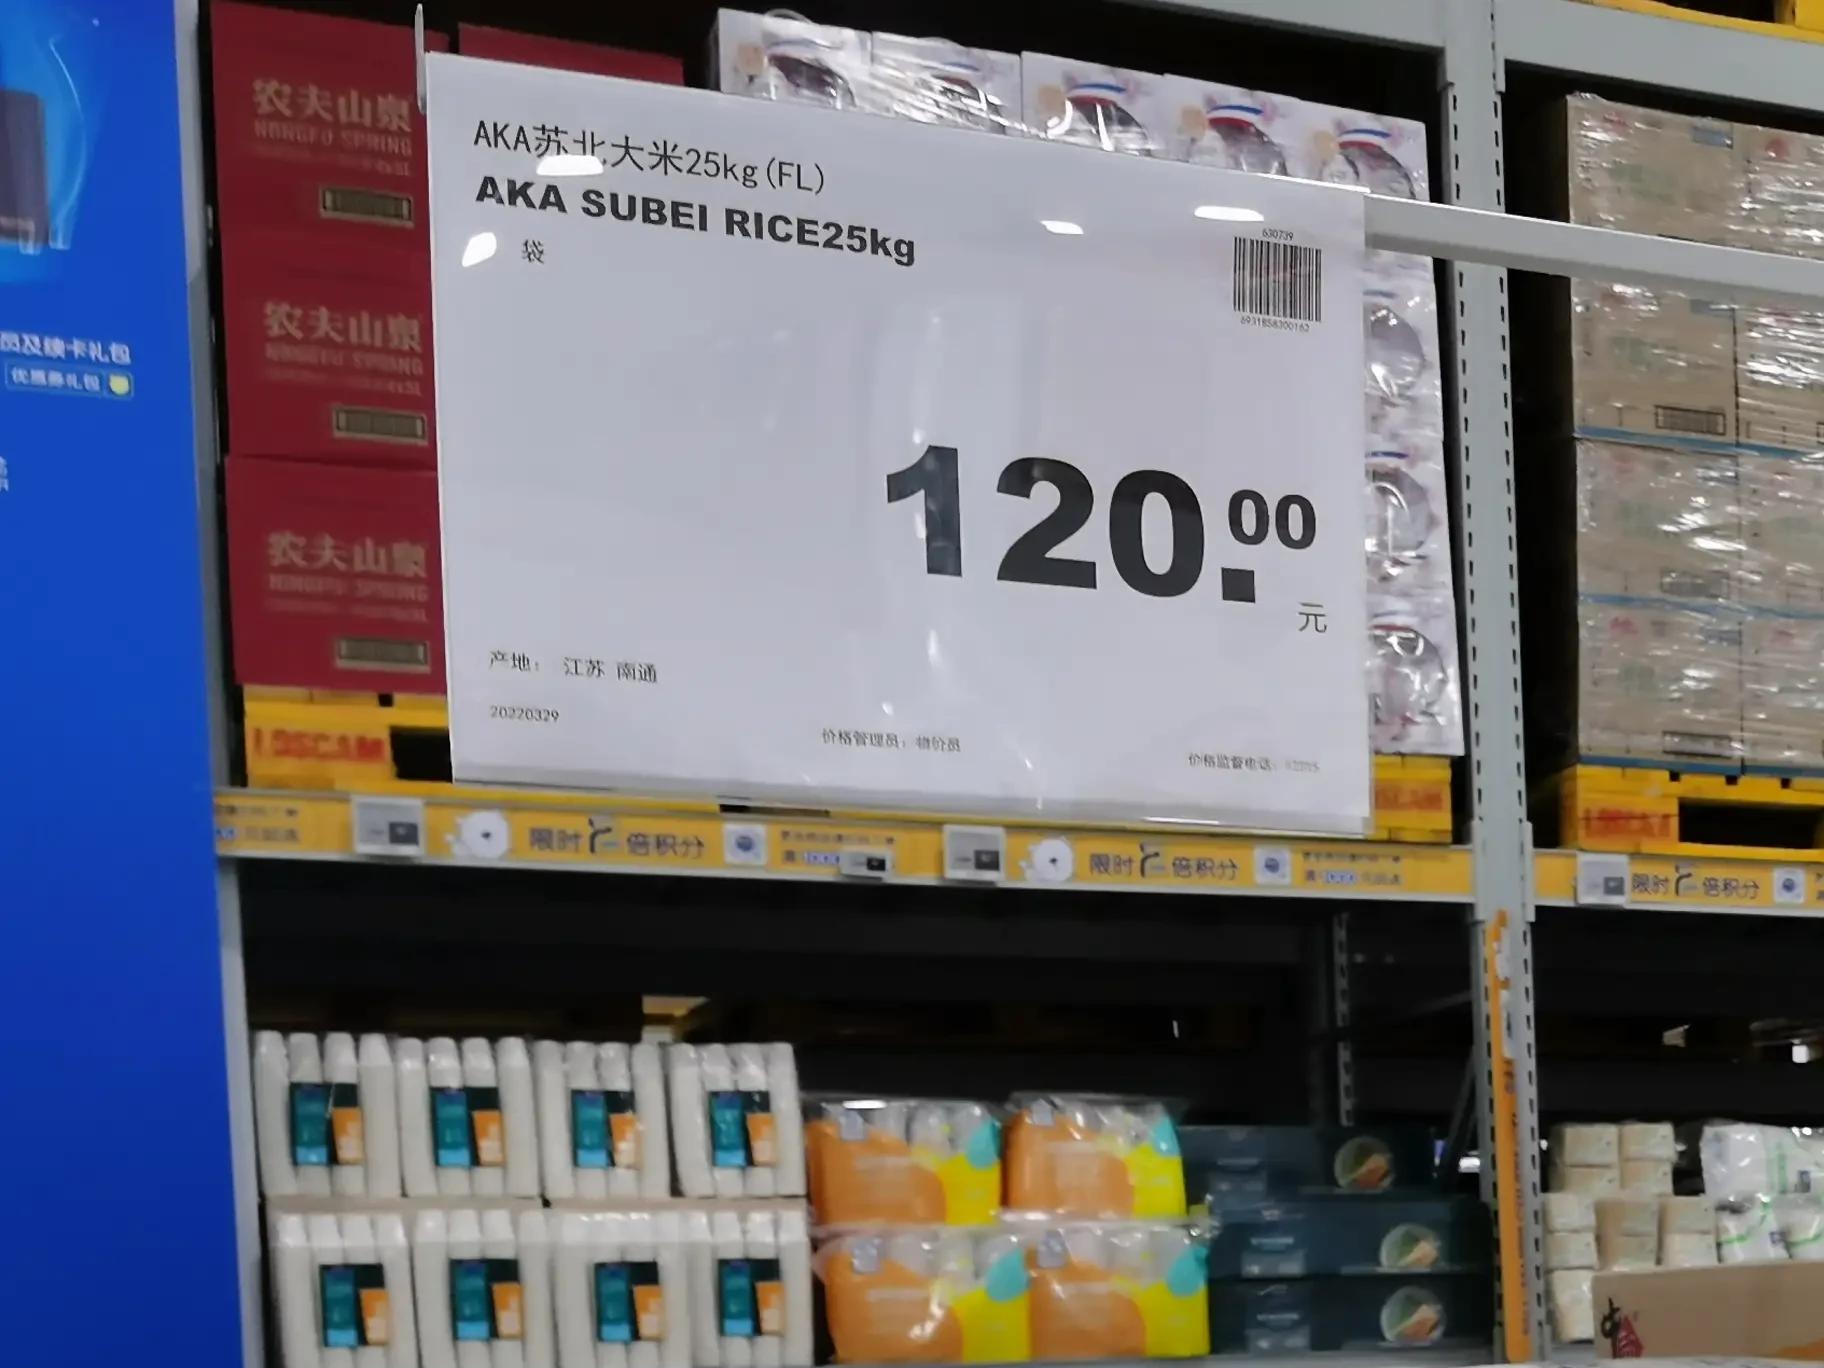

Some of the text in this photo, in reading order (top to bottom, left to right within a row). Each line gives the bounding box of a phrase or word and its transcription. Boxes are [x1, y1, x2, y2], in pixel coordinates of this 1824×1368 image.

[475, 175, 915, 267] AKA SUBEI RICE25kg
[521, 238, 546, 265] 袋
[1298, 602, 1328, 634] 元
[563, 656, 605, 679] 江苏
